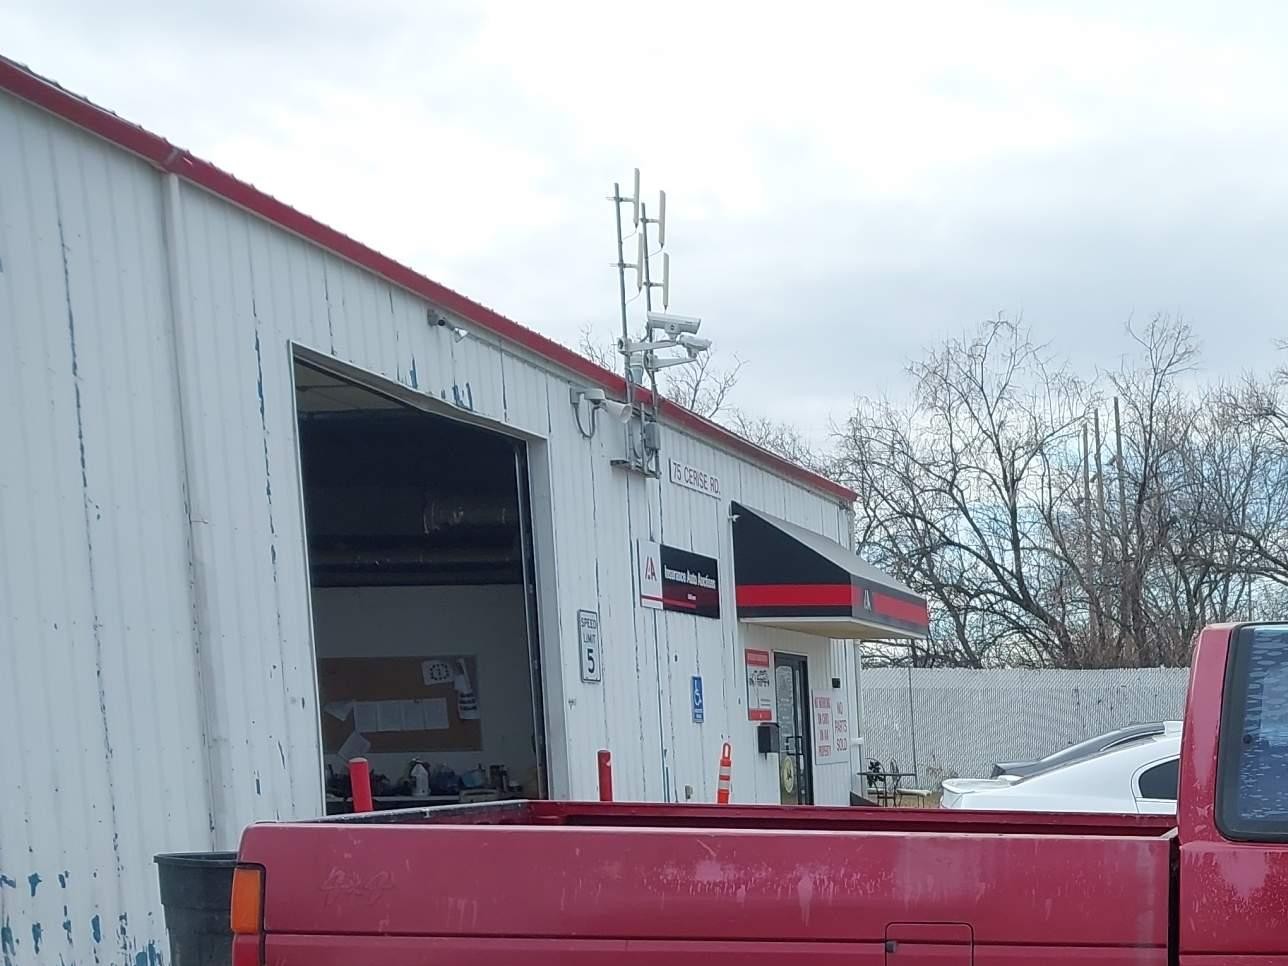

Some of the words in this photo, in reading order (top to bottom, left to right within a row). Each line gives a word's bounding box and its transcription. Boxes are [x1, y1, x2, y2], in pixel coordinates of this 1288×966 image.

[673, 462, 682, 480] 75
[684, 466, 708, 490] CERISE
[581, 617, 597, 629] SPEED
[583, 631, 597, 643] LIMIT
[587, 648, 595, 674] 5
